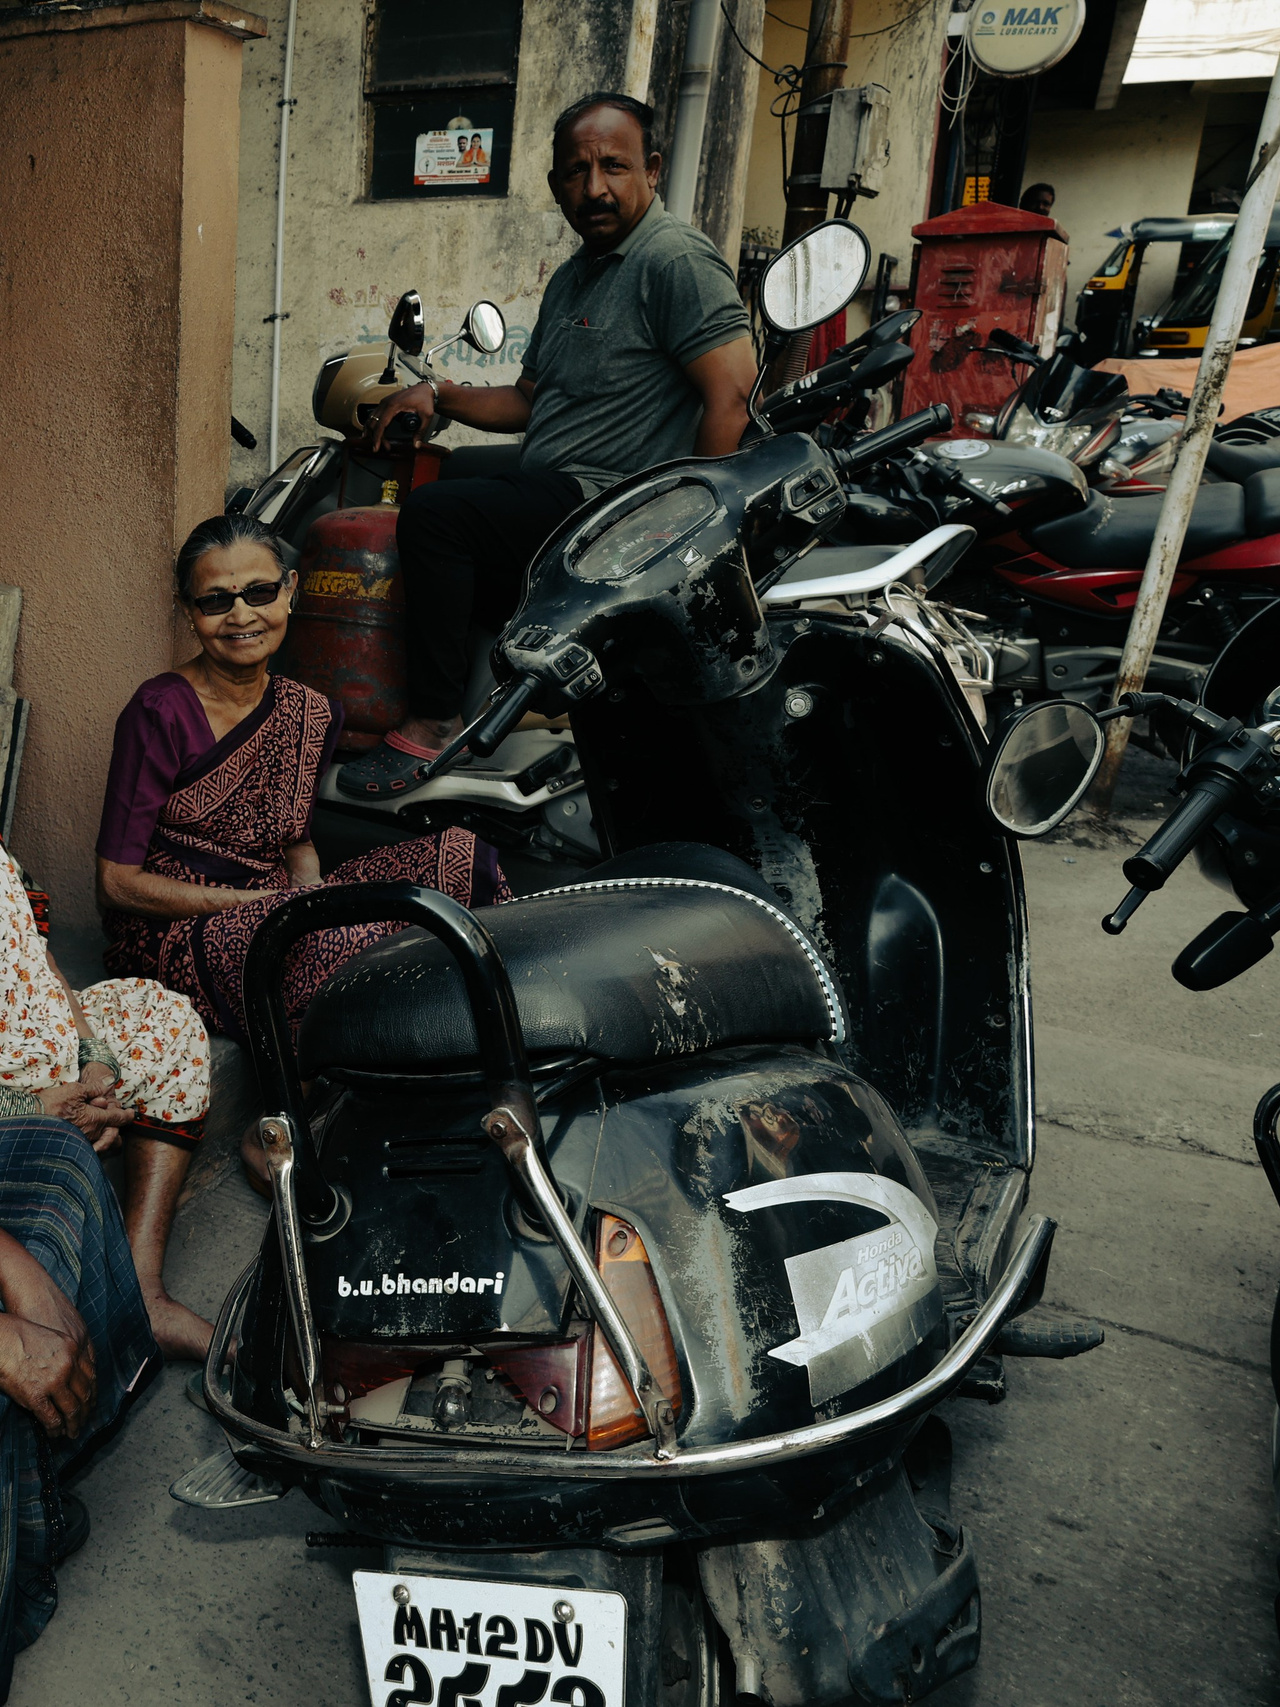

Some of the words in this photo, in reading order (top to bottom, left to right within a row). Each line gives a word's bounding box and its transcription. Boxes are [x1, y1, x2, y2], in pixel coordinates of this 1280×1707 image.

[1002, 7, 1063, 26] MAK
[1000, 27, 1059, 36] LUBRICANTS
[1043, 406, 1064, 417] TVS
[1120, 432, 1148, 447] TVS
[857, 1232, 902, 1265] Honda
[338, 1271, 505, 1297] b.u.bhandari
[820, 1246, 927, 1329] Activa
[524, 1617, 583, 1667] DV
